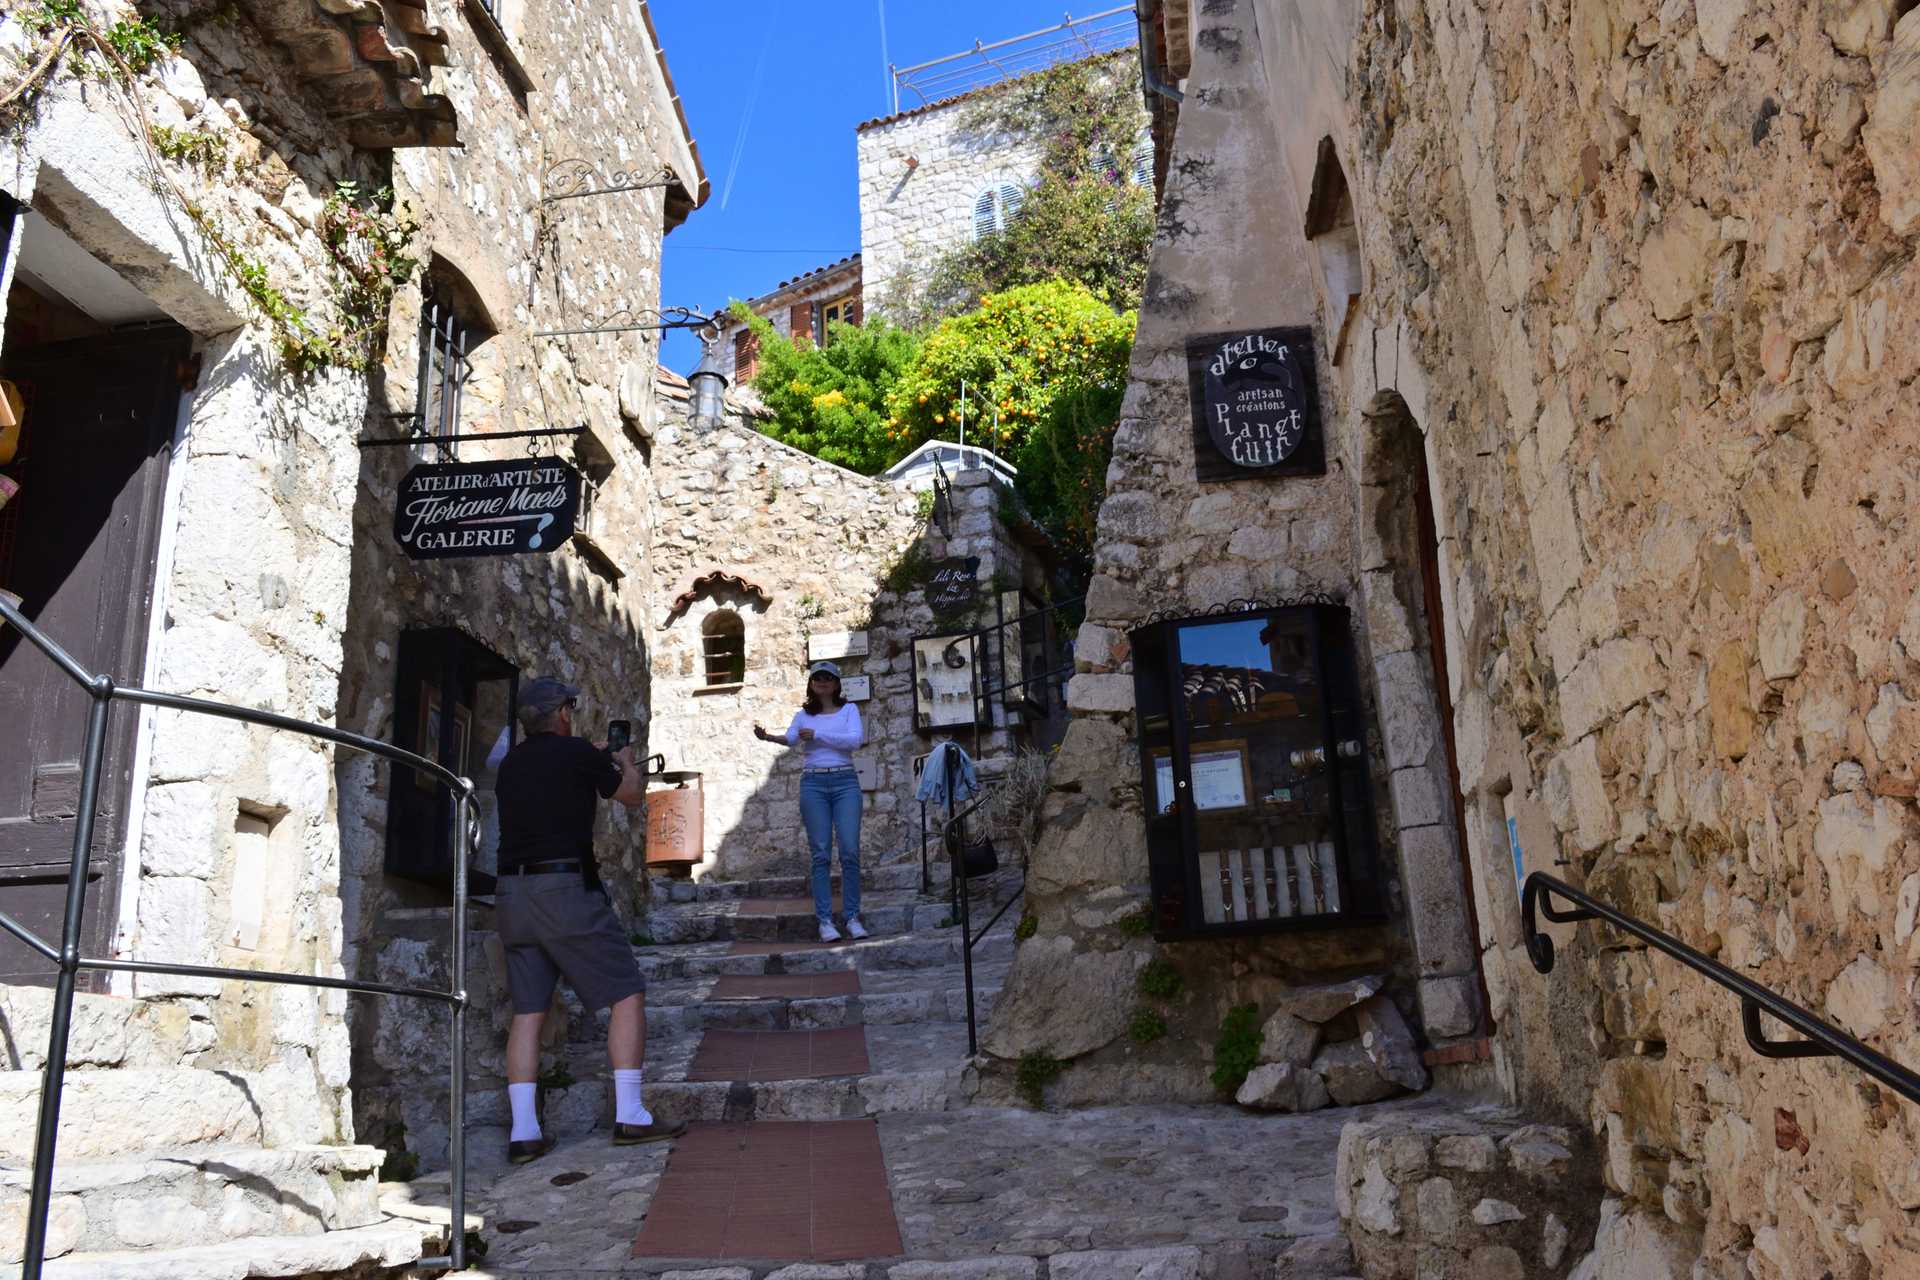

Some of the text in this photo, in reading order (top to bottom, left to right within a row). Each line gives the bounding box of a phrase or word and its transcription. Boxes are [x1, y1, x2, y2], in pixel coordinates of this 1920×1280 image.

[1237, 388, 1284, 401] artisan
[408, 474, 482, 492] ATELIER
[401, 494, 505, 542] Floriane
[416, 528, 516, 550] GALERIE
[952, 570, 971, 582] Rose
